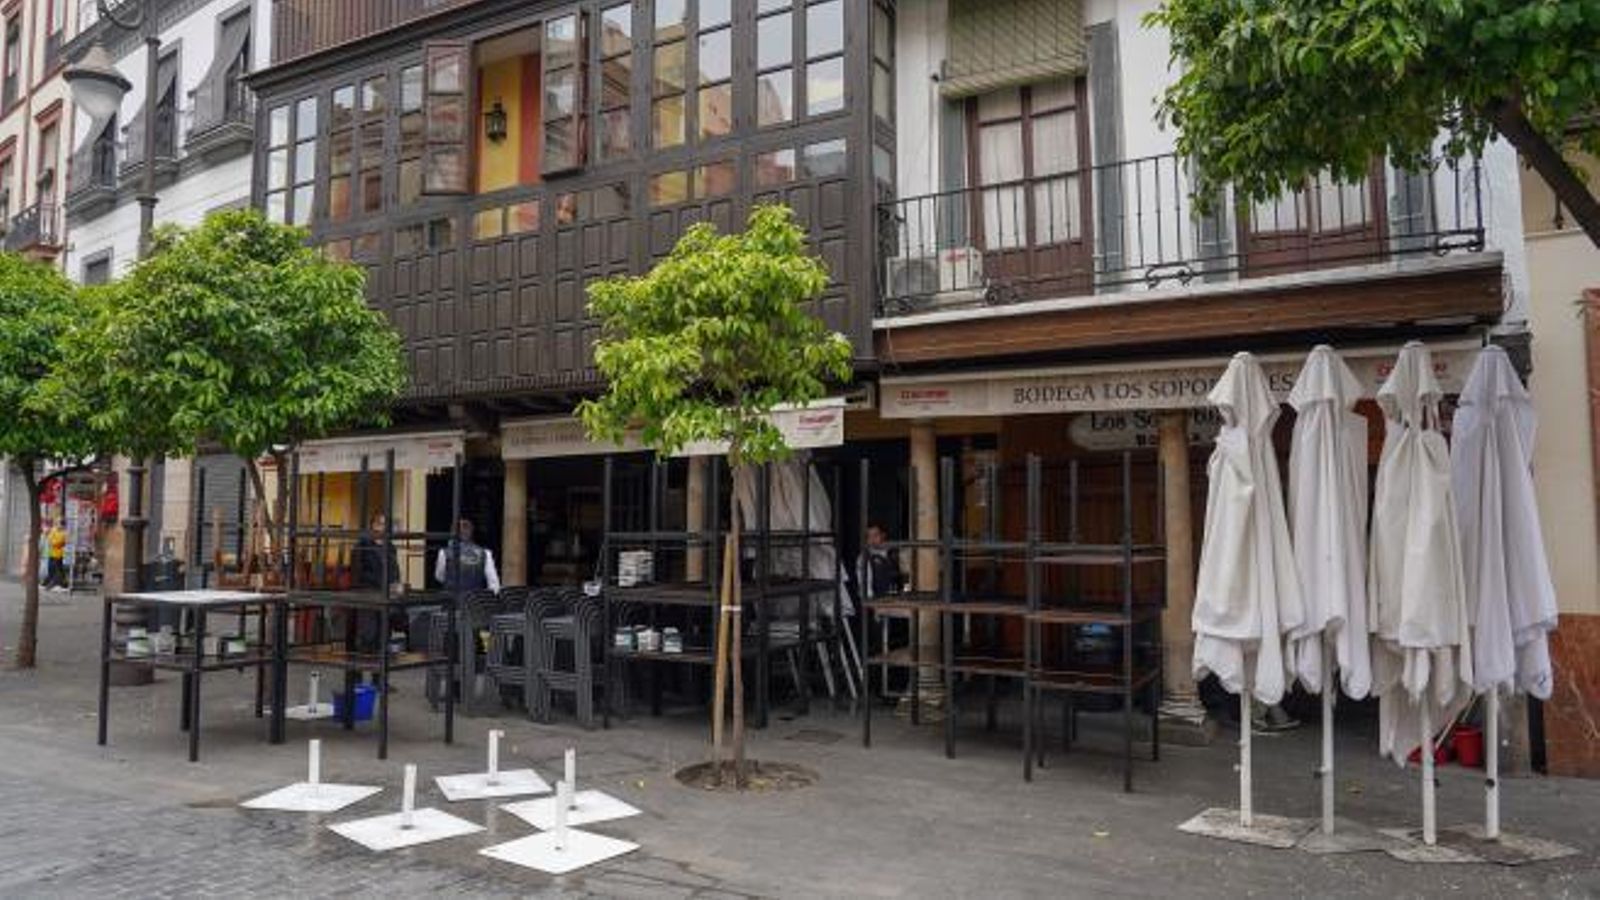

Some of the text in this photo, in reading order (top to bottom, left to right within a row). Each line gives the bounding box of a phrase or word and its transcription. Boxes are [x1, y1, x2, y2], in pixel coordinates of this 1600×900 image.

[1013, 372, 1293, 405] BODEGA LOS SOPOES
